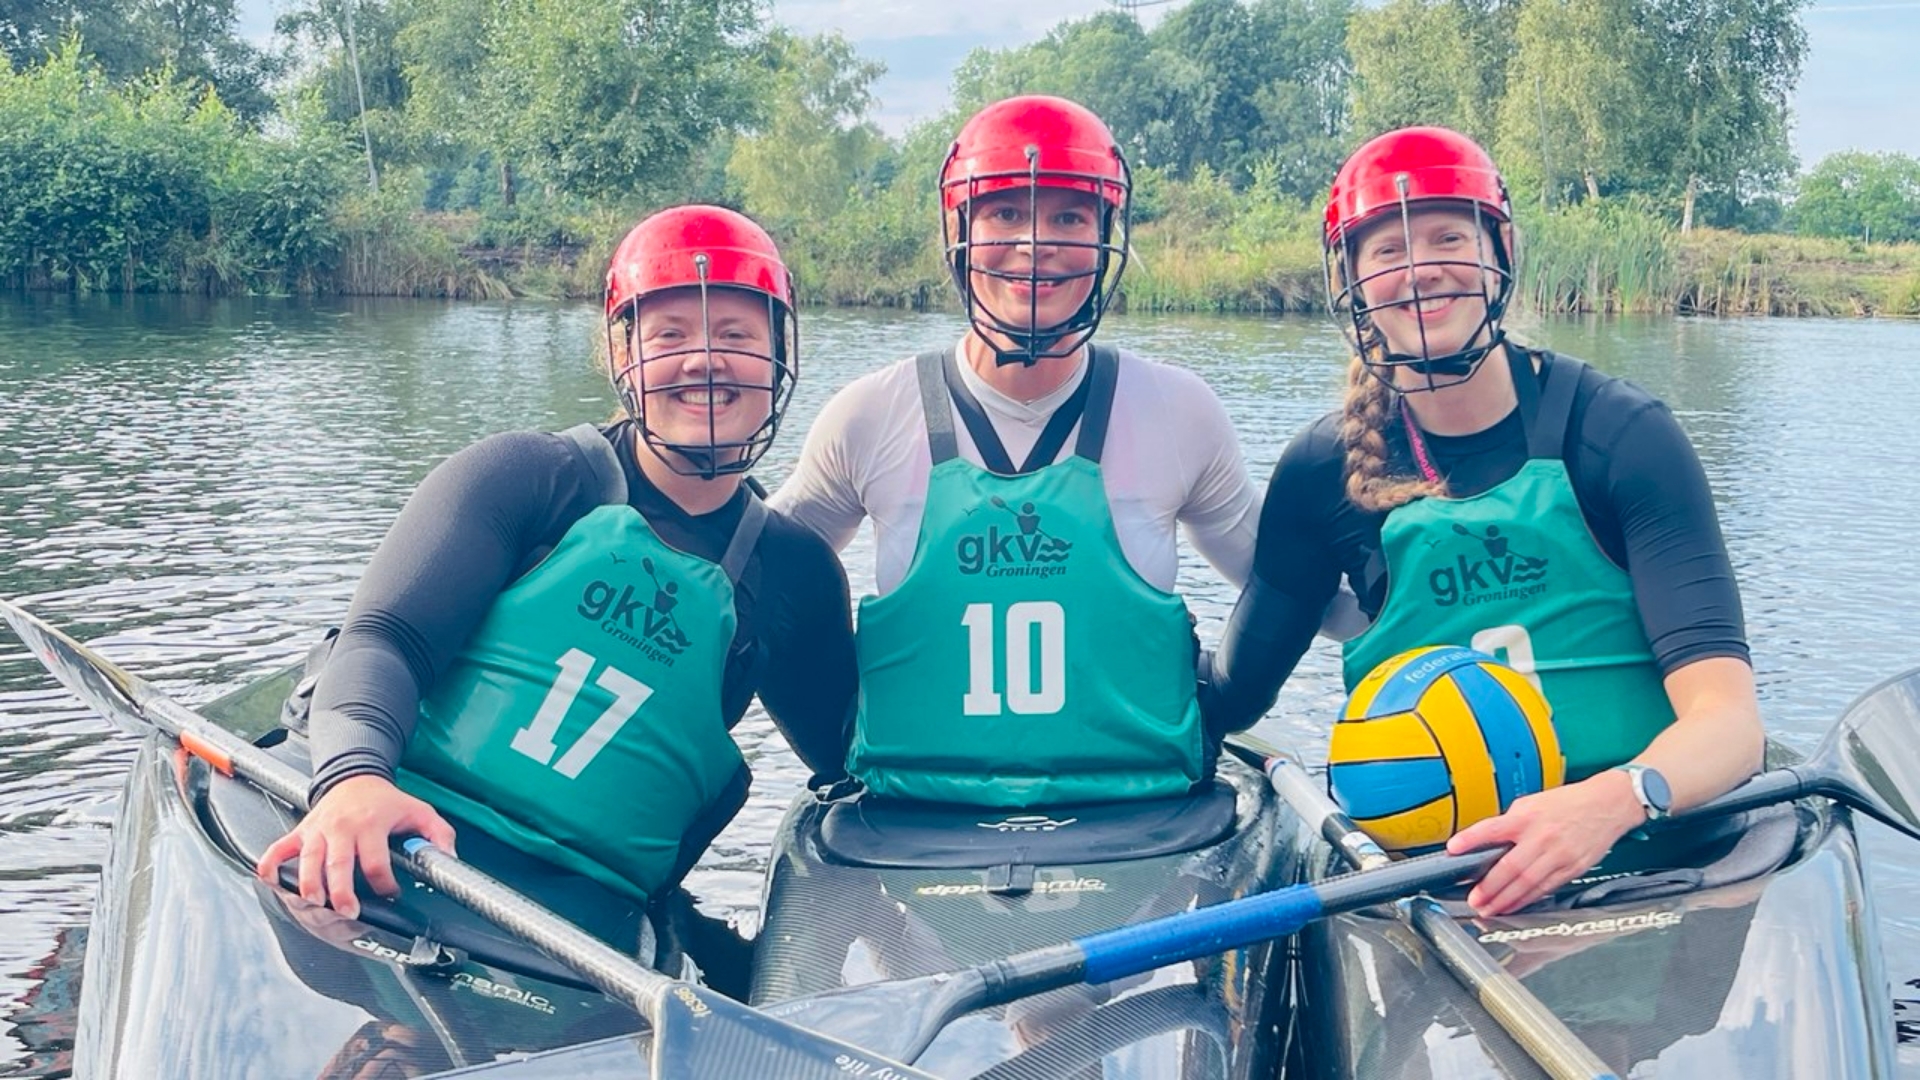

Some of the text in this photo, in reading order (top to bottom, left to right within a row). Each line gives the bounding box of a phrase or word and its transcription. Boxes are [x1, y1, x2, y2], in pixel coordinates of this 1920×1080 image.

[958, 525, 1042, 575] gkv
[986, 563, 1067, 579] Groningen
[1429, 554, 1514, 607] gkv
[1462, 582, 1547, 607] Groningen
[577, 580, 671, 639] gkv
[601, 619, 676, 668] Groningen
[960, 600, 1066, 716] 10
[509, 647, 655, 781] 17
[835, 1054, 870, 1075] life
